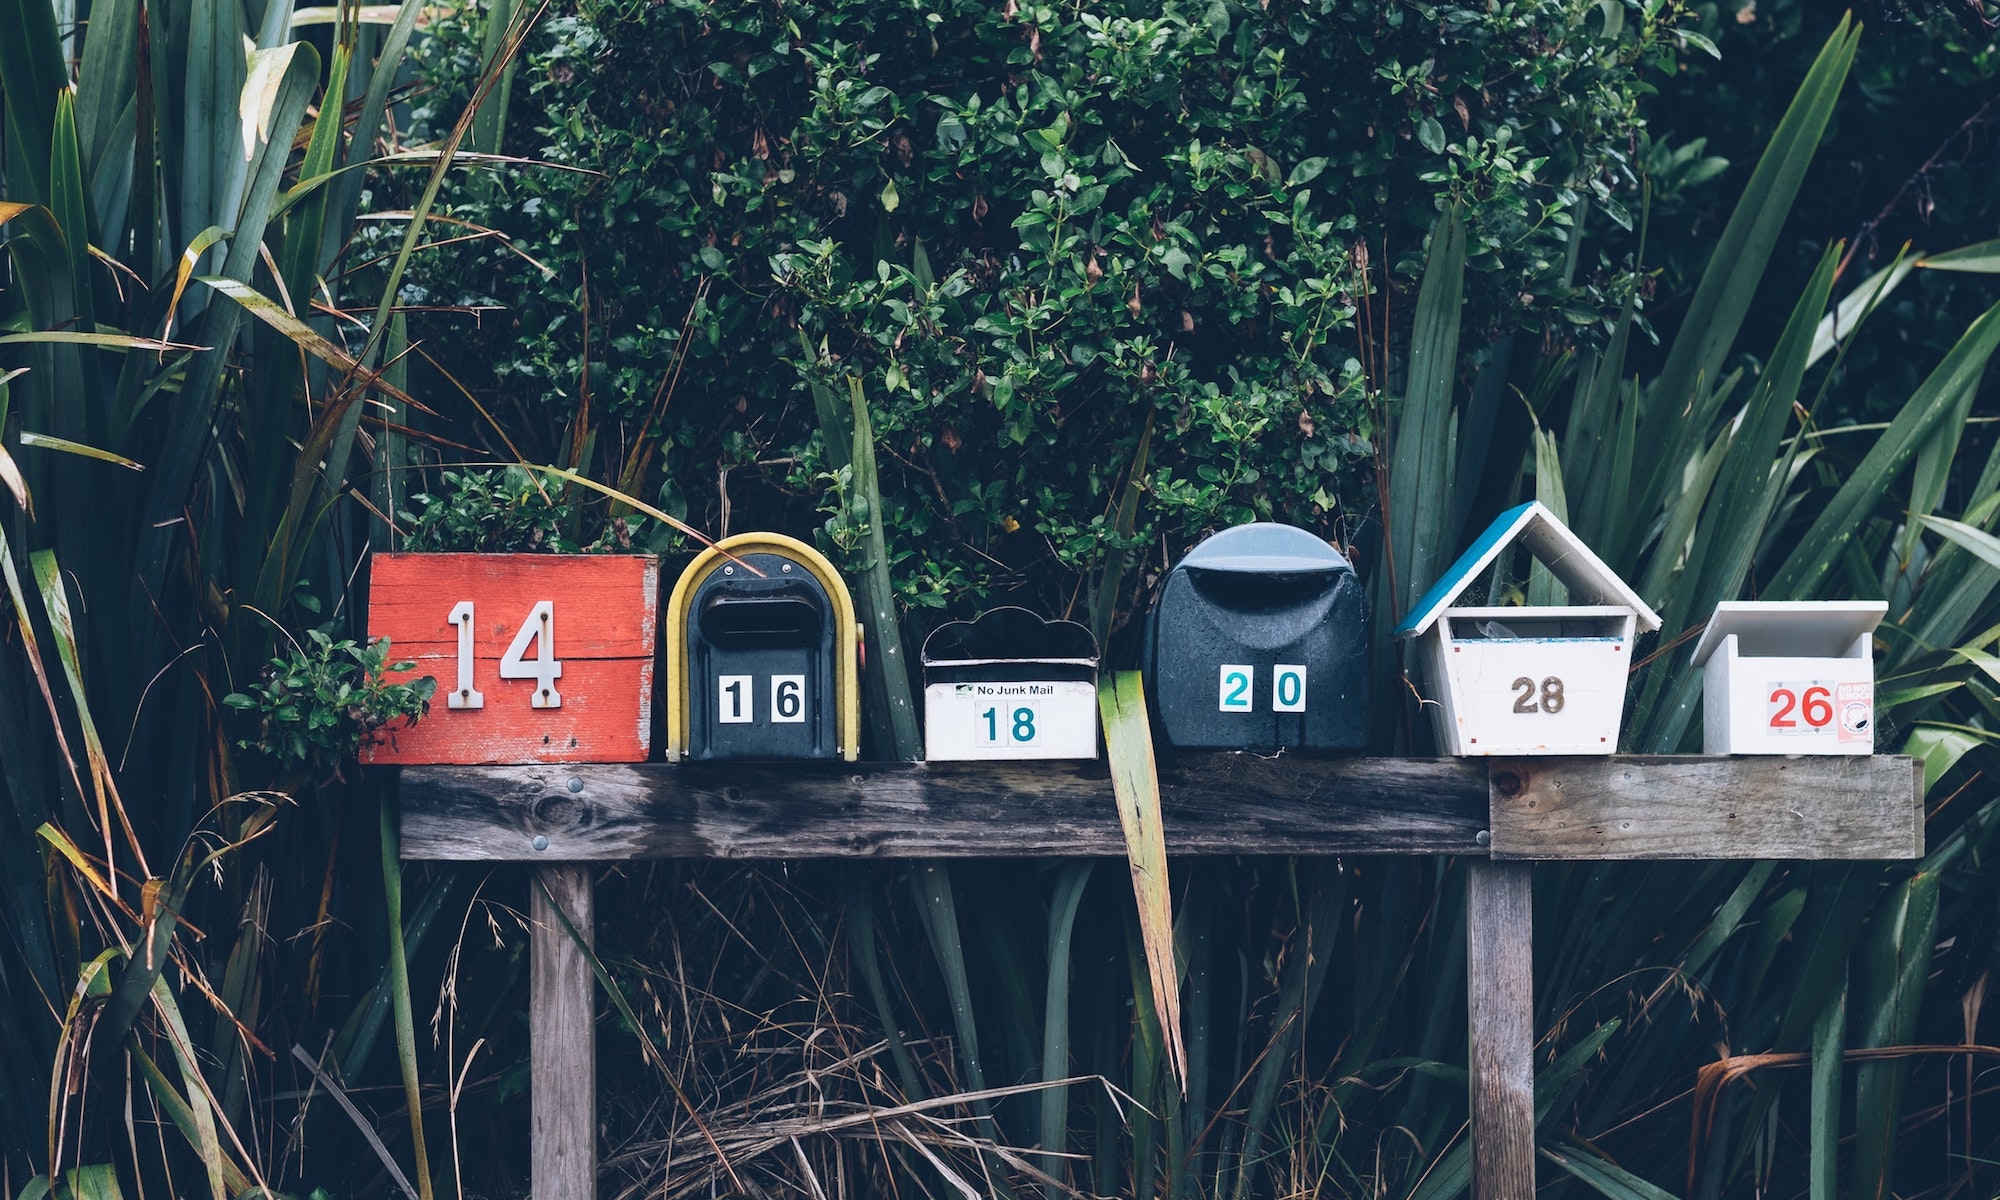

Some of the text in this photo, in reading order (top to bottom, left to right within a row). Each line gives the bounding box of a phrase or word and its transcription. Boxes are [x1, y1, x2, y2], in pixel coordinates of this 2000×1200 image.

[448, 600, 563, 709] 14
[977, 685, 1054, 695] No Junk Mail
[1511, 675, 1565, 714] 28
[1769, 686, 1834, 728] 26
[1838, 685, 1852, 693] DO
[982, 707, 1036, 742] 18
